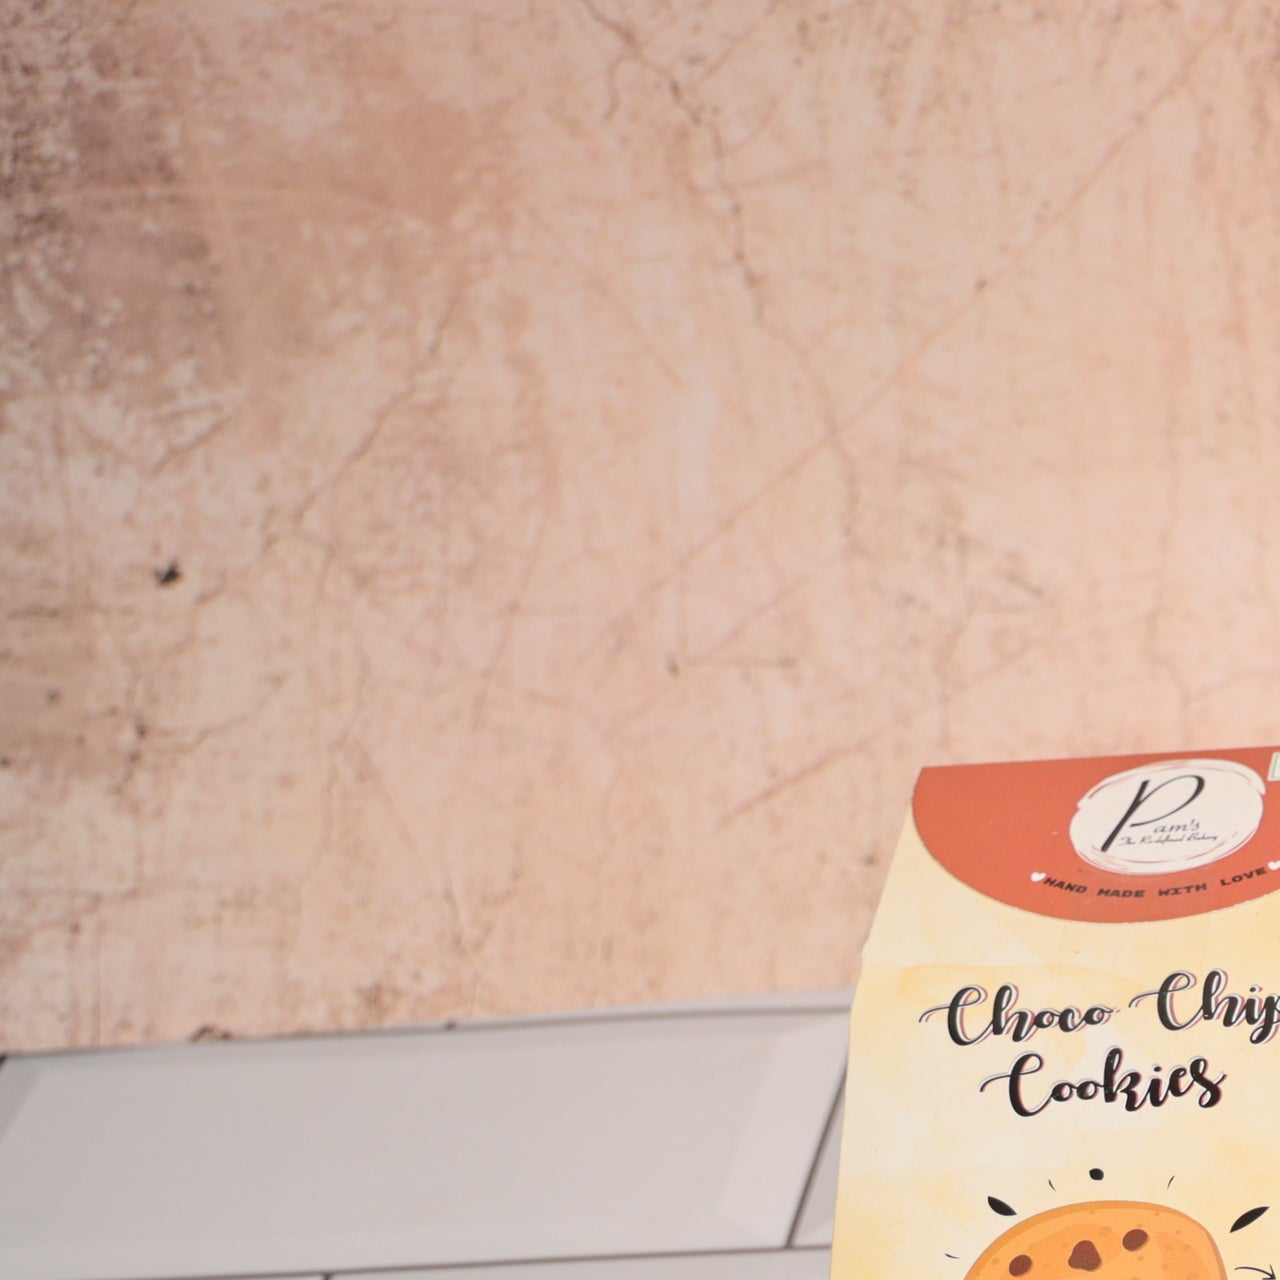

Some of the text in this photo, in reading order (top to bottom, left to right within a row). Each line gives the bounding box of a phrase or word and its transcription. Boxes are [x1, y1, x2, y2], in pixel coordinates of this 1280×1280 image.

[1043, 866, 1268, 898] HAND MADE WITH LOVE
[919, 983, 1121, 1046] Choco
[980, 1046, 1227, 1118] Cookies
